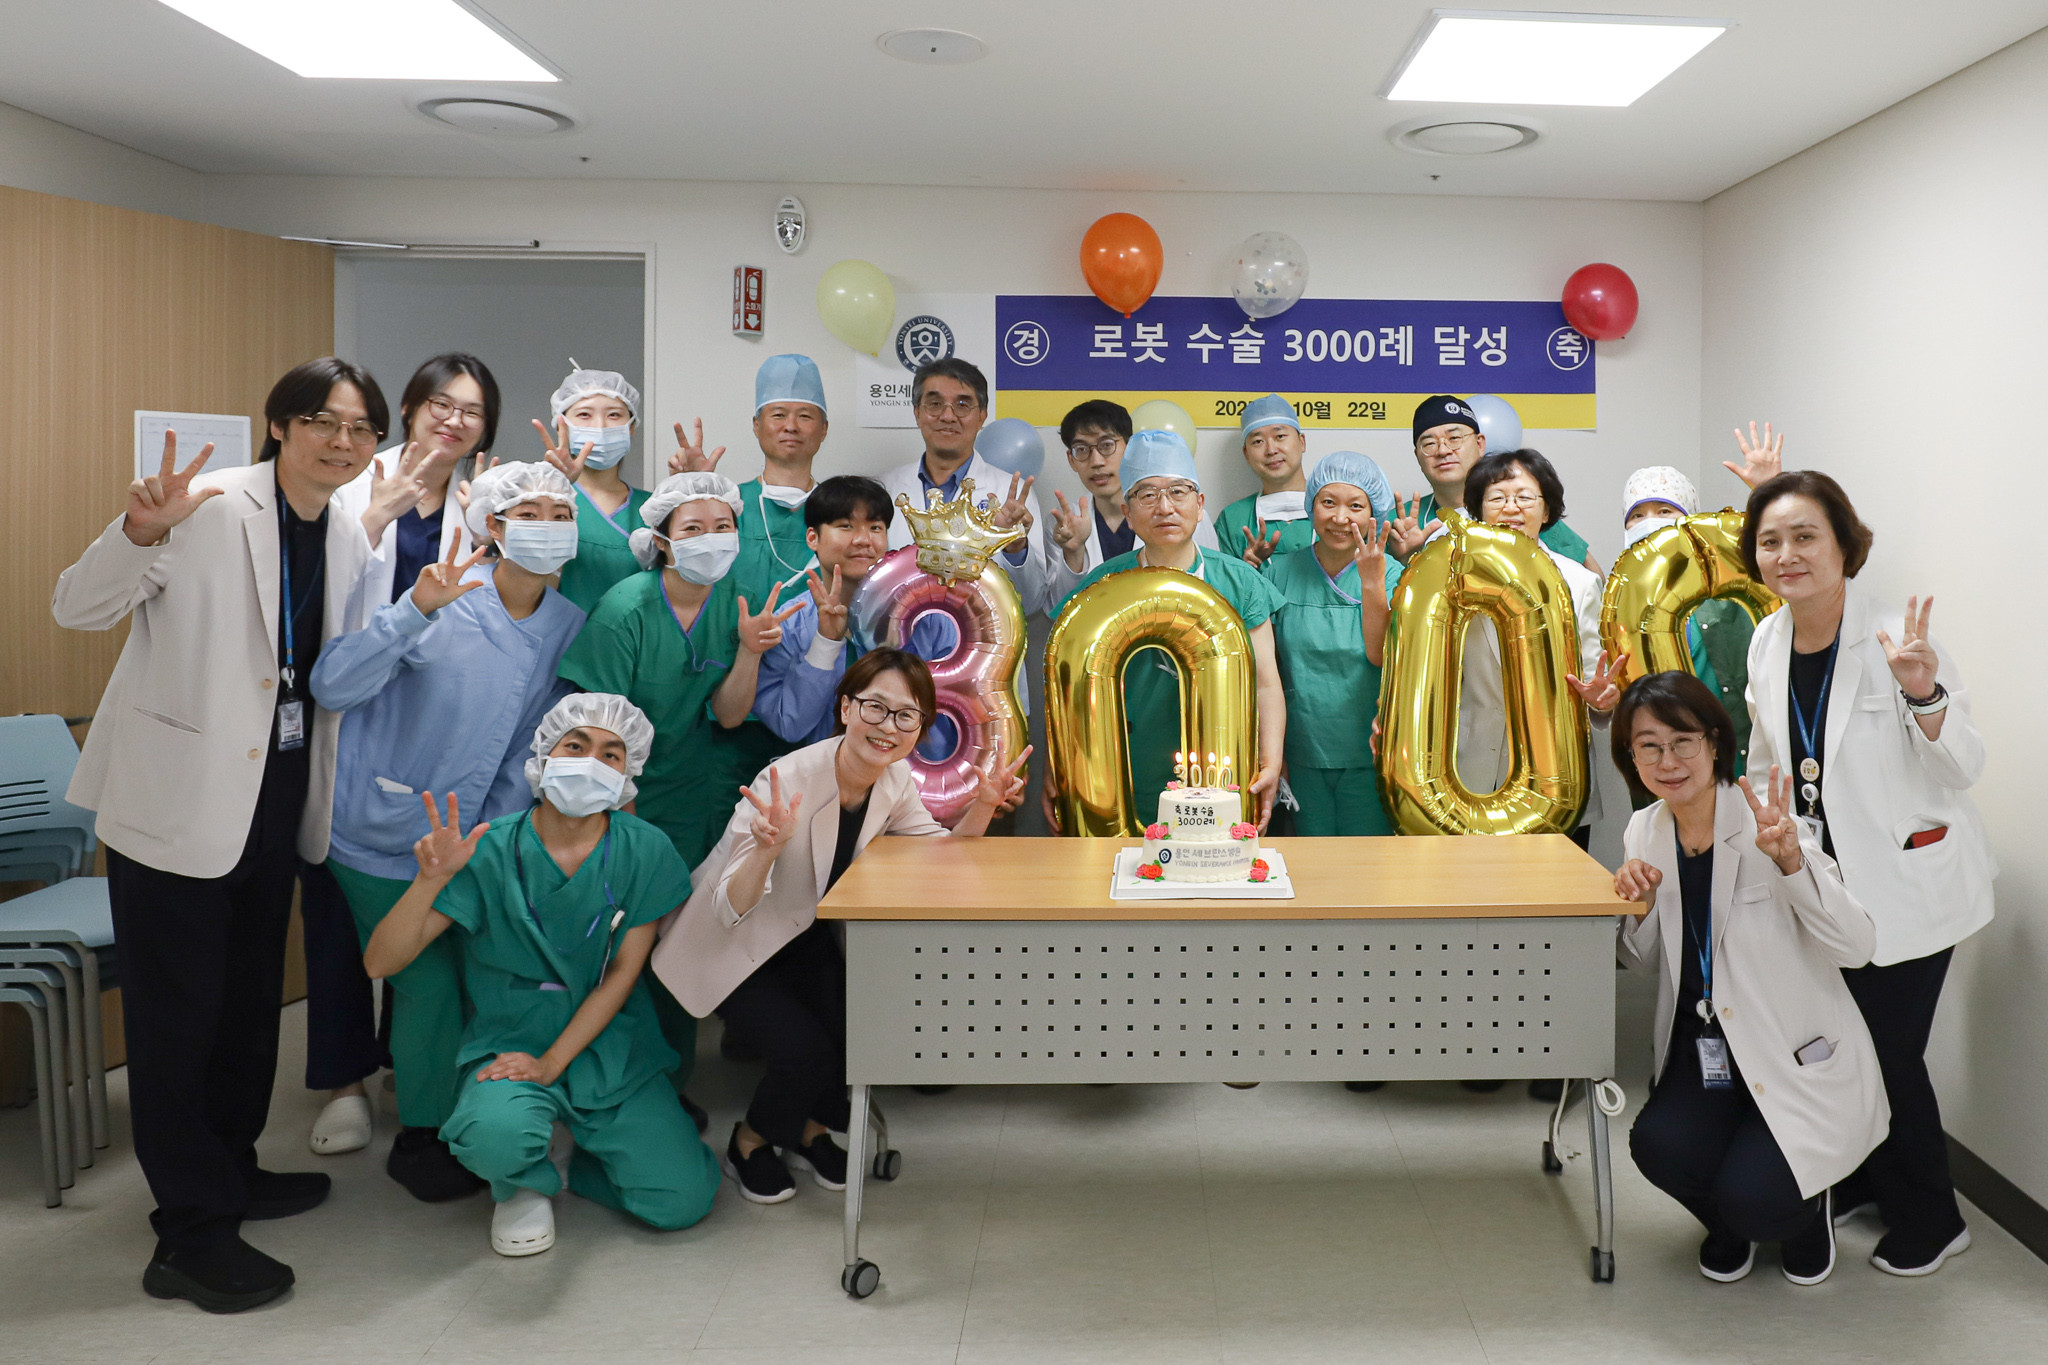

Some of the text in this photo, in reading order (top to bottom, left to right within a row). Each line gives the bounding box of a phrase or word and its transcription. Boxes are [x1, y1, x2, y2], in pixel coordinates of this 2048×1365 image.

[897, 317, 953, 346] YONSEI UNIVERSITY
[1012, 322, 1583, 367] 경 로봇 수술 3000례 달성 축
[869, 384, 911, 398] 용인세
[1215, 400, 1386, 420] 202 10월 22일
[1173, 763, 1232, 789] 3000
[1184, 805, 1198, 816] 로봇
[1200, 806, 1214, 817] 수술
[1178, 817, 1215, 826] 3000례
